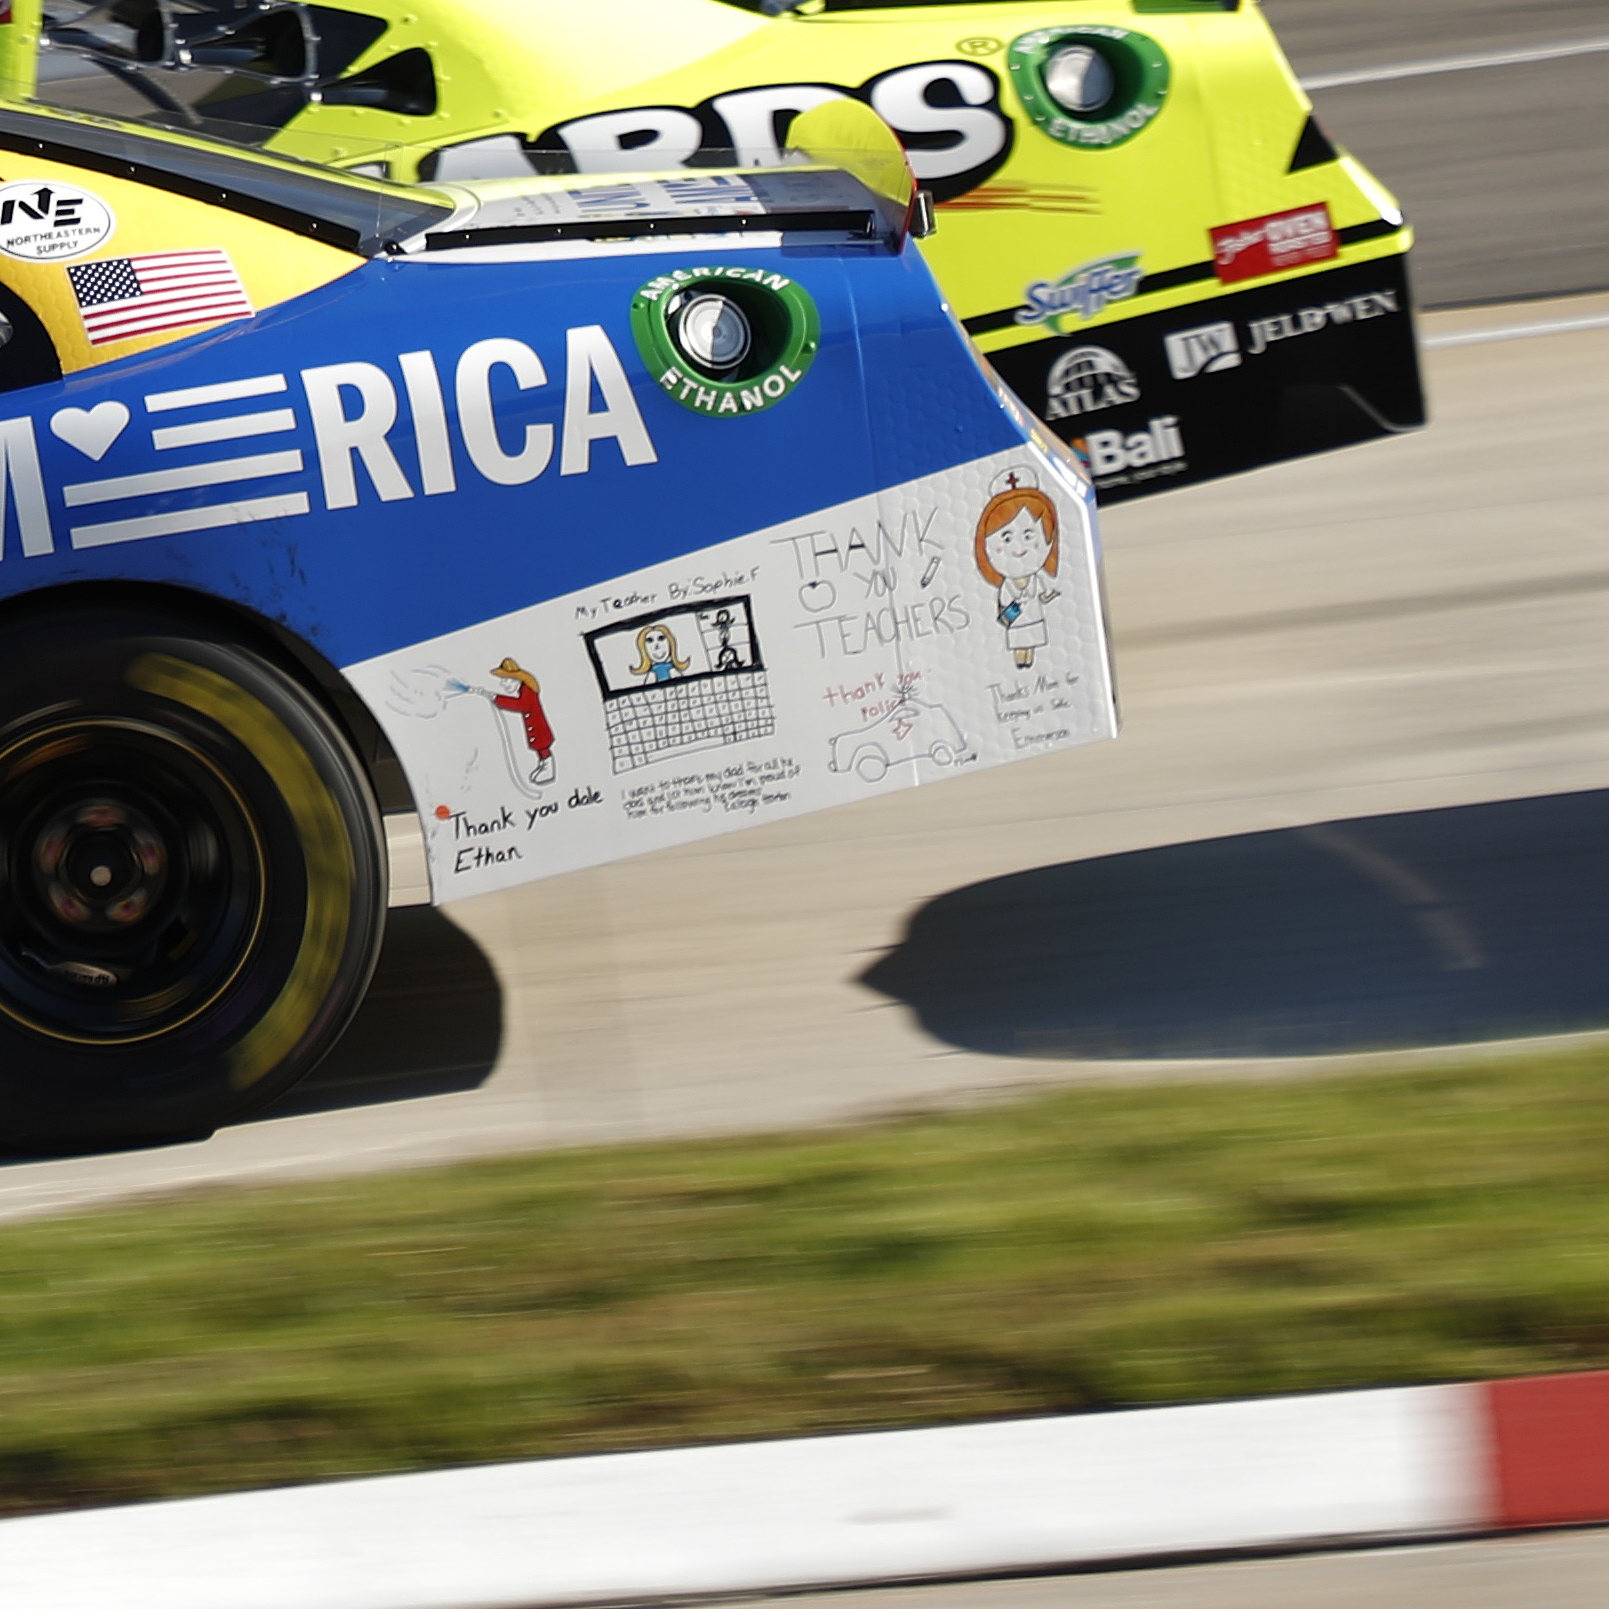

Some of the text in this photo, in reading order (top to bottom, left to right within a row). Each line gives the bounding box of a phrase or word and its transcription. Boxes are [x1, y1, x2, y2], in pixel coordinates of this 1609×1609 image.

[5, 225, 102, 250] NORTHEASTERN
[35, 239, 80, 256] SUPPLY
[640, 266, 791, 301] AMERICAN
[1015, 265, 1144, 326] Swiffer
[659, 365, 803, 414] ETHANOL
[1045, 377, 1141, 421] ATLAS
[1085, 414, 1185, 477] Bali
[769, 506, 945, 579] THANK
[852, 566, 898, 599] YOU
[574, 605, 598, 621] My
[793, 594, 971, 659] TEACHERS
[449, 805, 516, 841] Thank
[525, 801, 560, 832] you
[454, 846, 524, 875] Ethan
